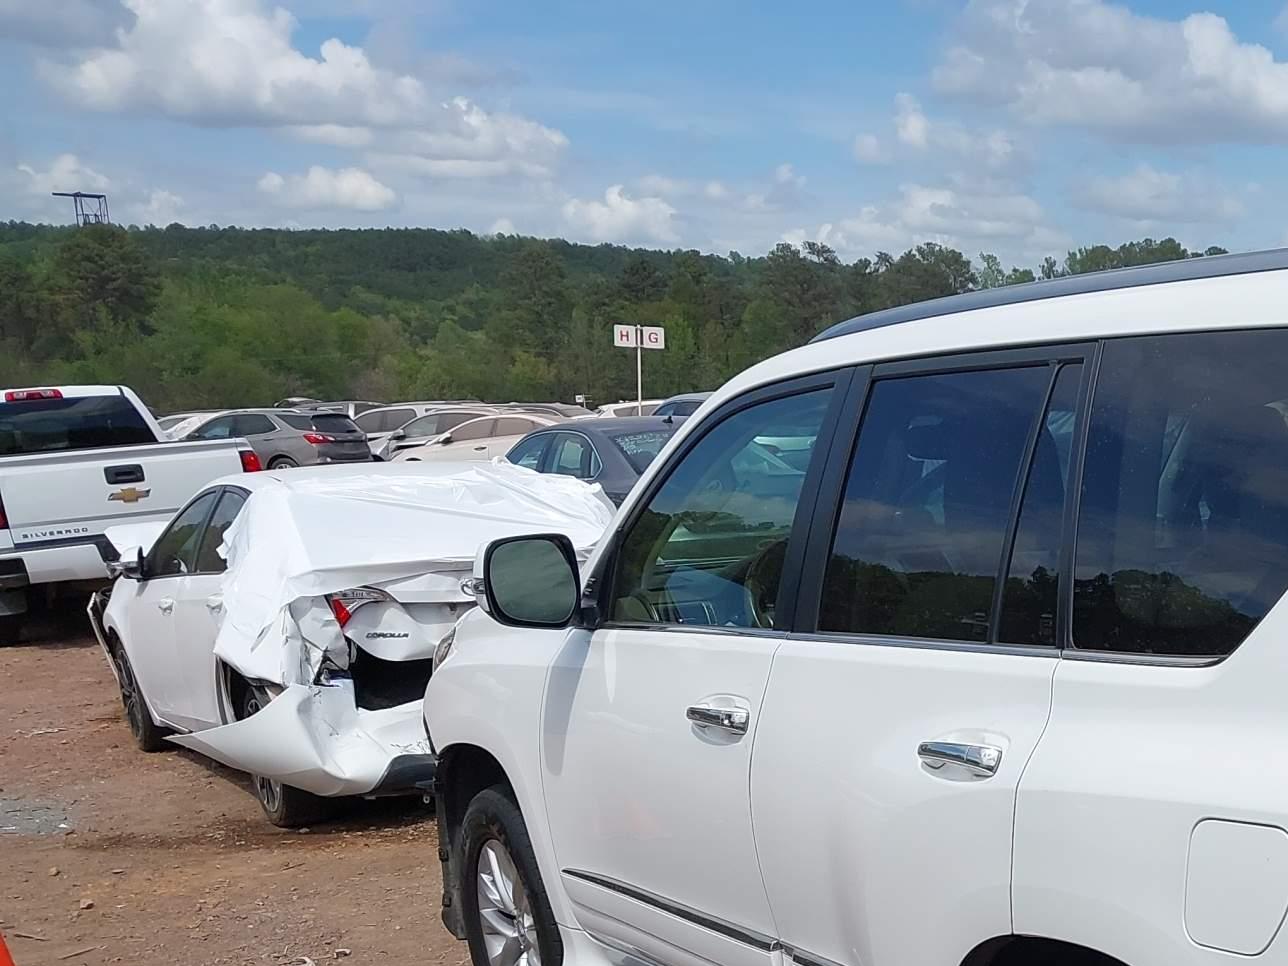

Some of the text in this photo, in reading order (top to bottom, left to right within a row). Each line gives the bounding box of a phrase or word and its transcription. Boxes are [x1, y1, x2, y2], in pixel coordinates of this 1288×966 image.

[619, 329, 659, 344] H G
[21, 526, 89, 539] SILVERADO
[365, 631, 410, 639] COROLLA
